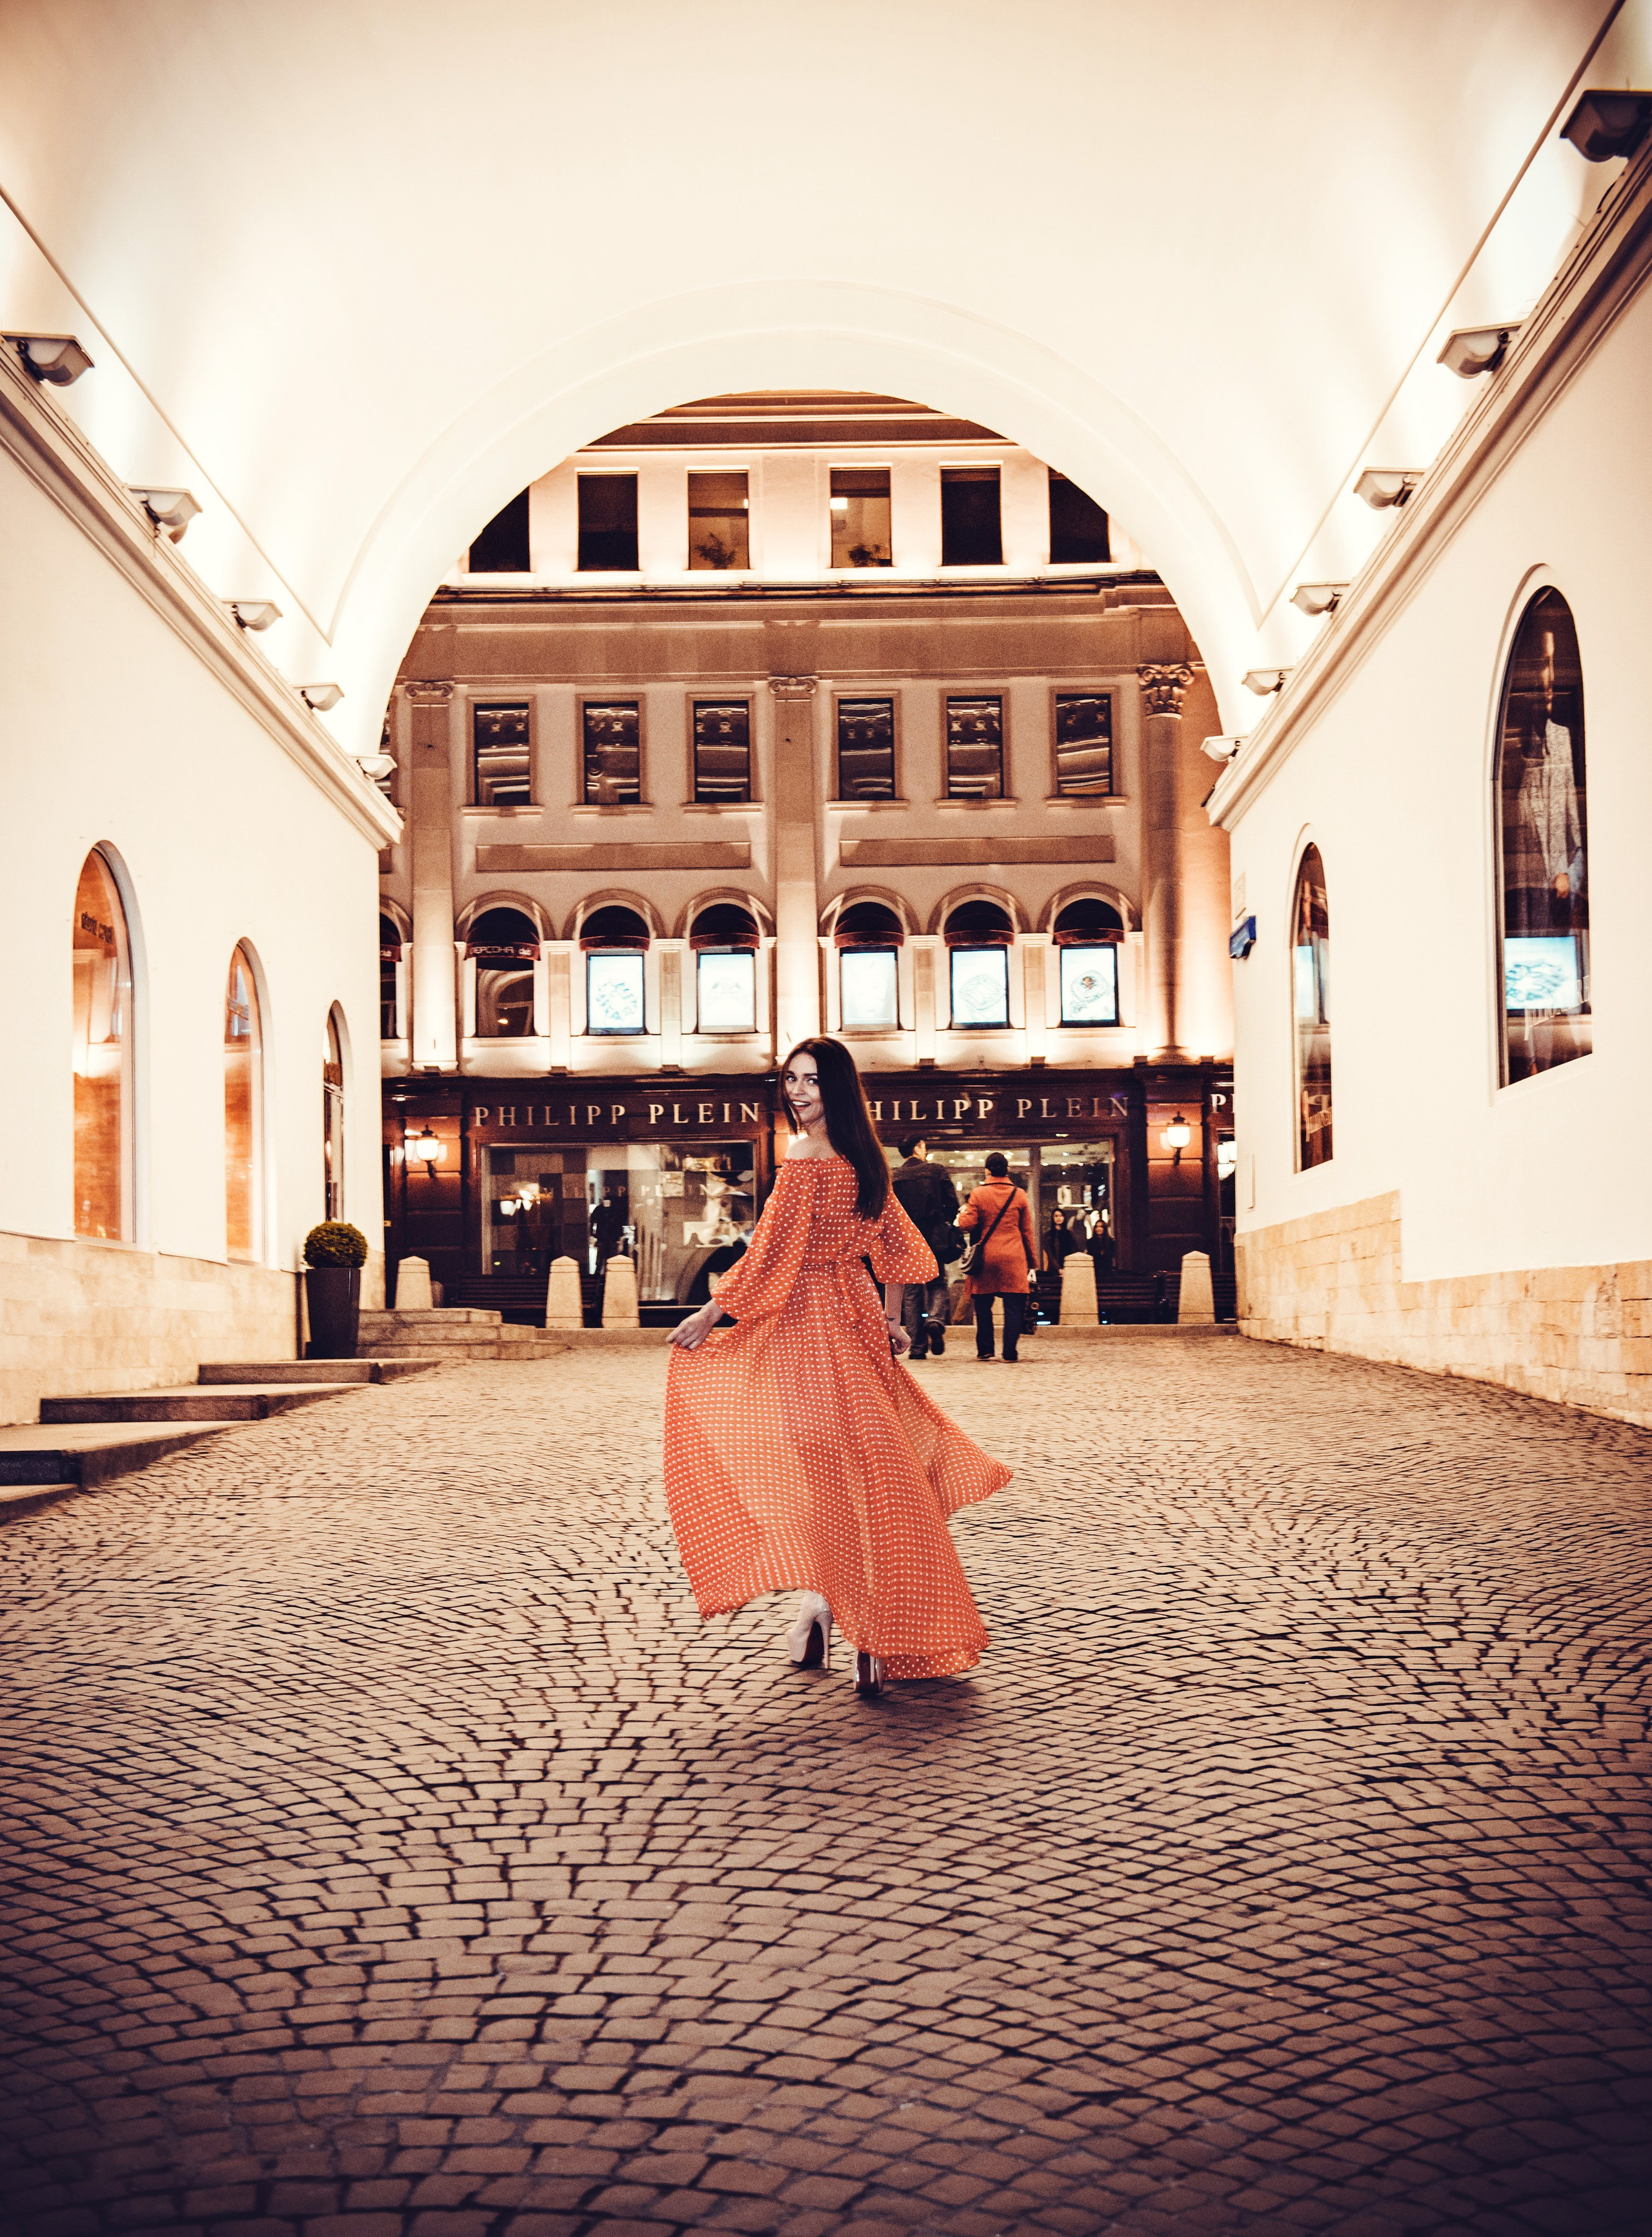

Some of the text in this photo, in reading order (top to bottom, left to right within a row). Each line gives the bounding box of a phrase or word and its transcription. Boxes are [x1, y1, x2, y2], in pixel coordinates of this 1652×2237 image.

[474, 1102, 760, 1127] PHILIPP PLEIN
[865, 1097, 1129, 1120] HILIPP PLEIN
[1210, 1093, 1234, 1113] P
